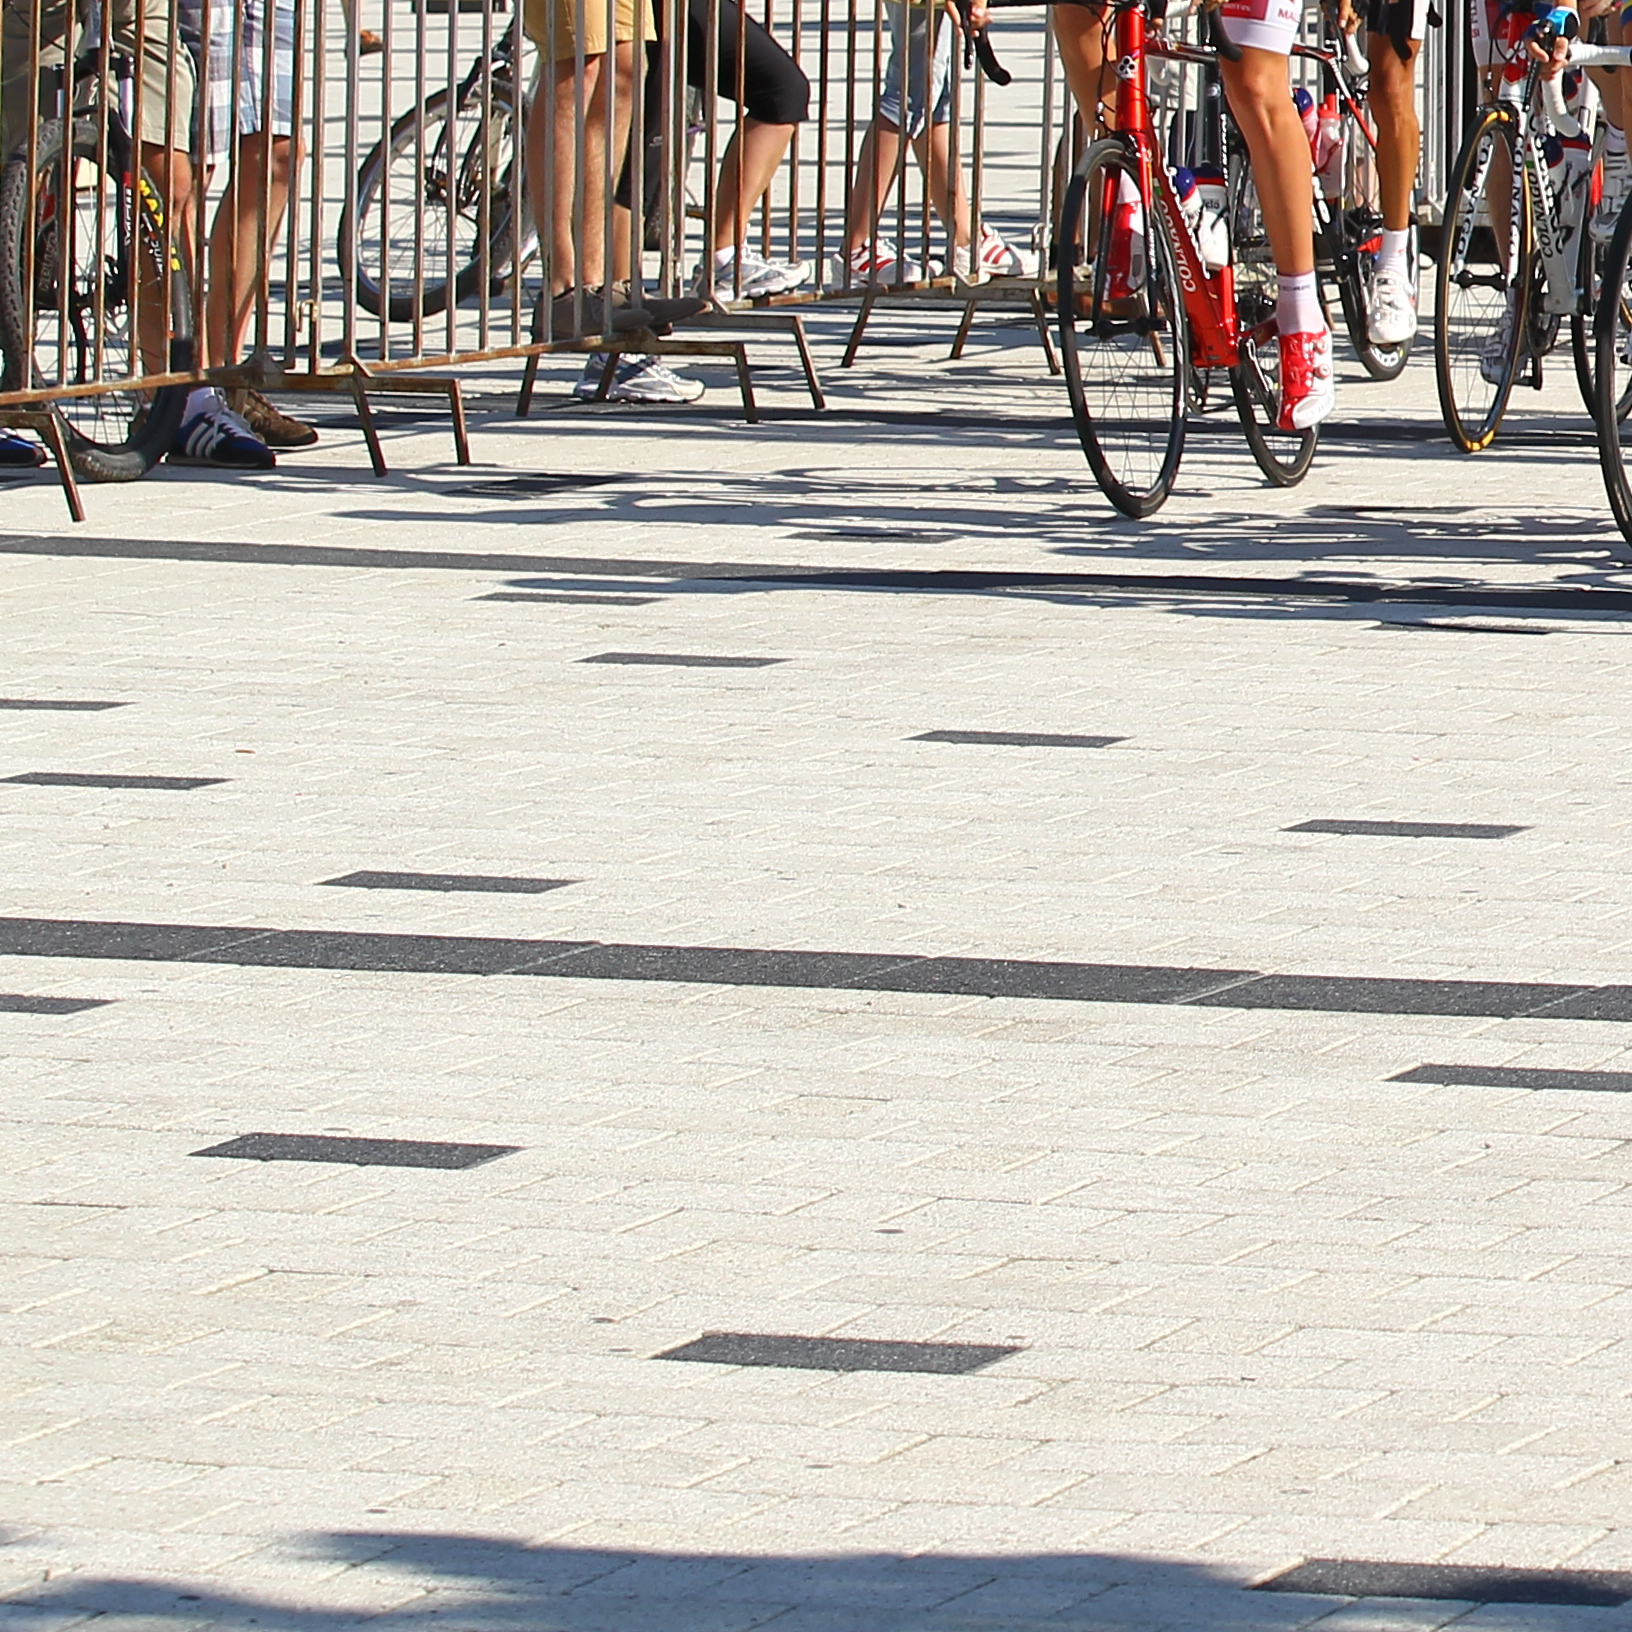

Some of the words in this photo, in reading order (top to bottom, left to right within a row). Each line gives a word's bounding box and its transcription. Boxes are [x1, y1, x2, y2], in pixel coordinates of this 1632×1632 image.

[1456, 133, 1494, 256] COLNAGO
[1508, 134, 1525, 257] COLNAGO
[1528, 172, 1554, 259] COLNAGO
